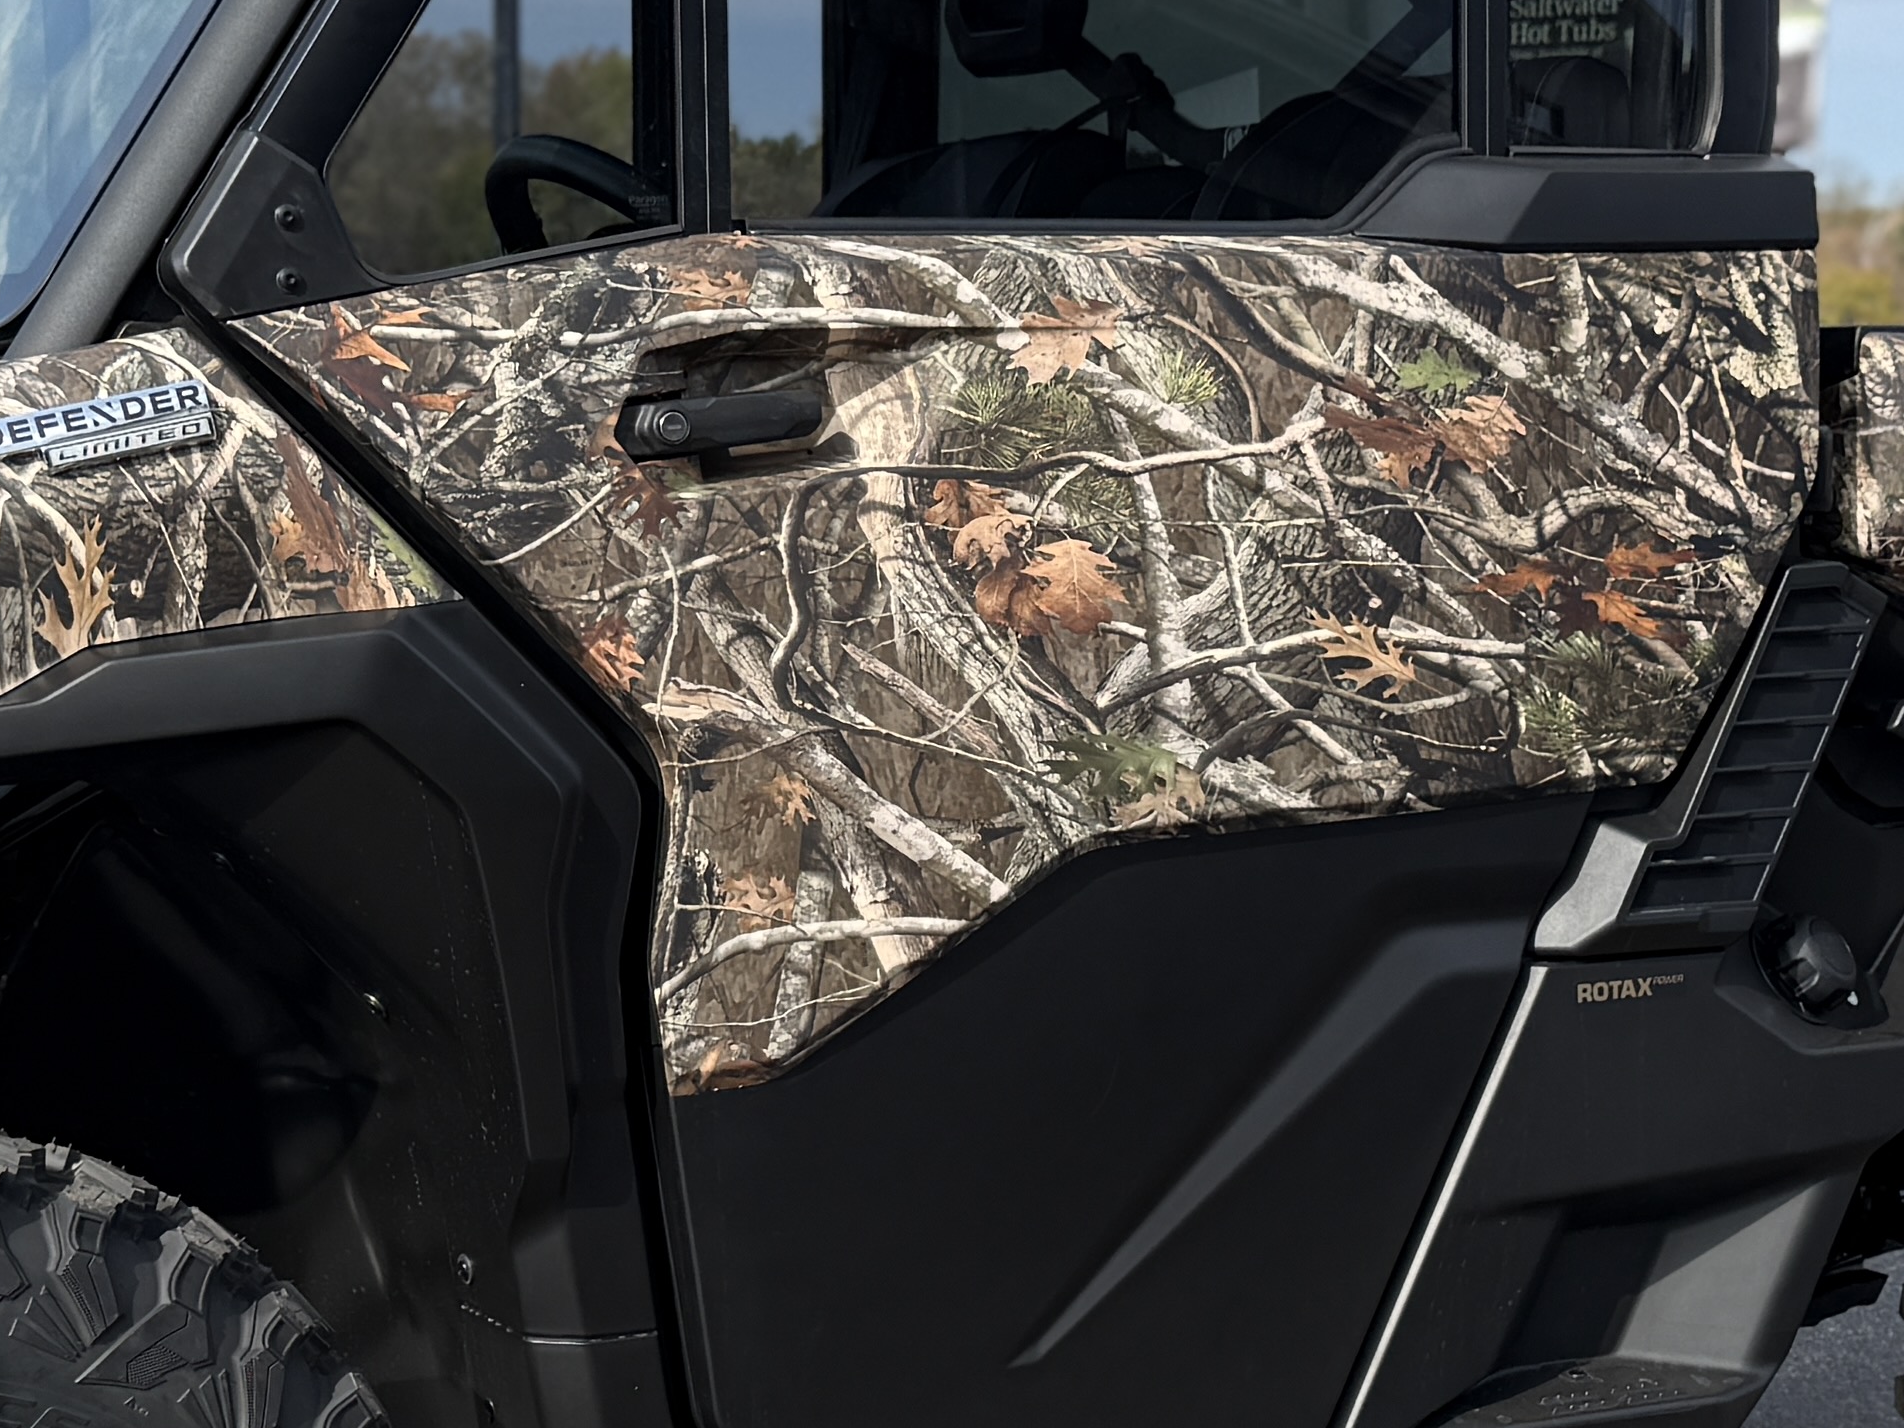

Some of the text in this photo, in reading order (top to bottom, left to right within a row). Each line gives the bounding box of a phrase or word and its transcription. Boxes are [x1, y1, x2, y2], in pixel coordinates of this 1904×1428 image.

[1510, 19, 1617, 46] Hot Tubs
[58, 422, 202, 461] LIMITED
[1577, 974, 1684, 1004] ROTAX POWER
